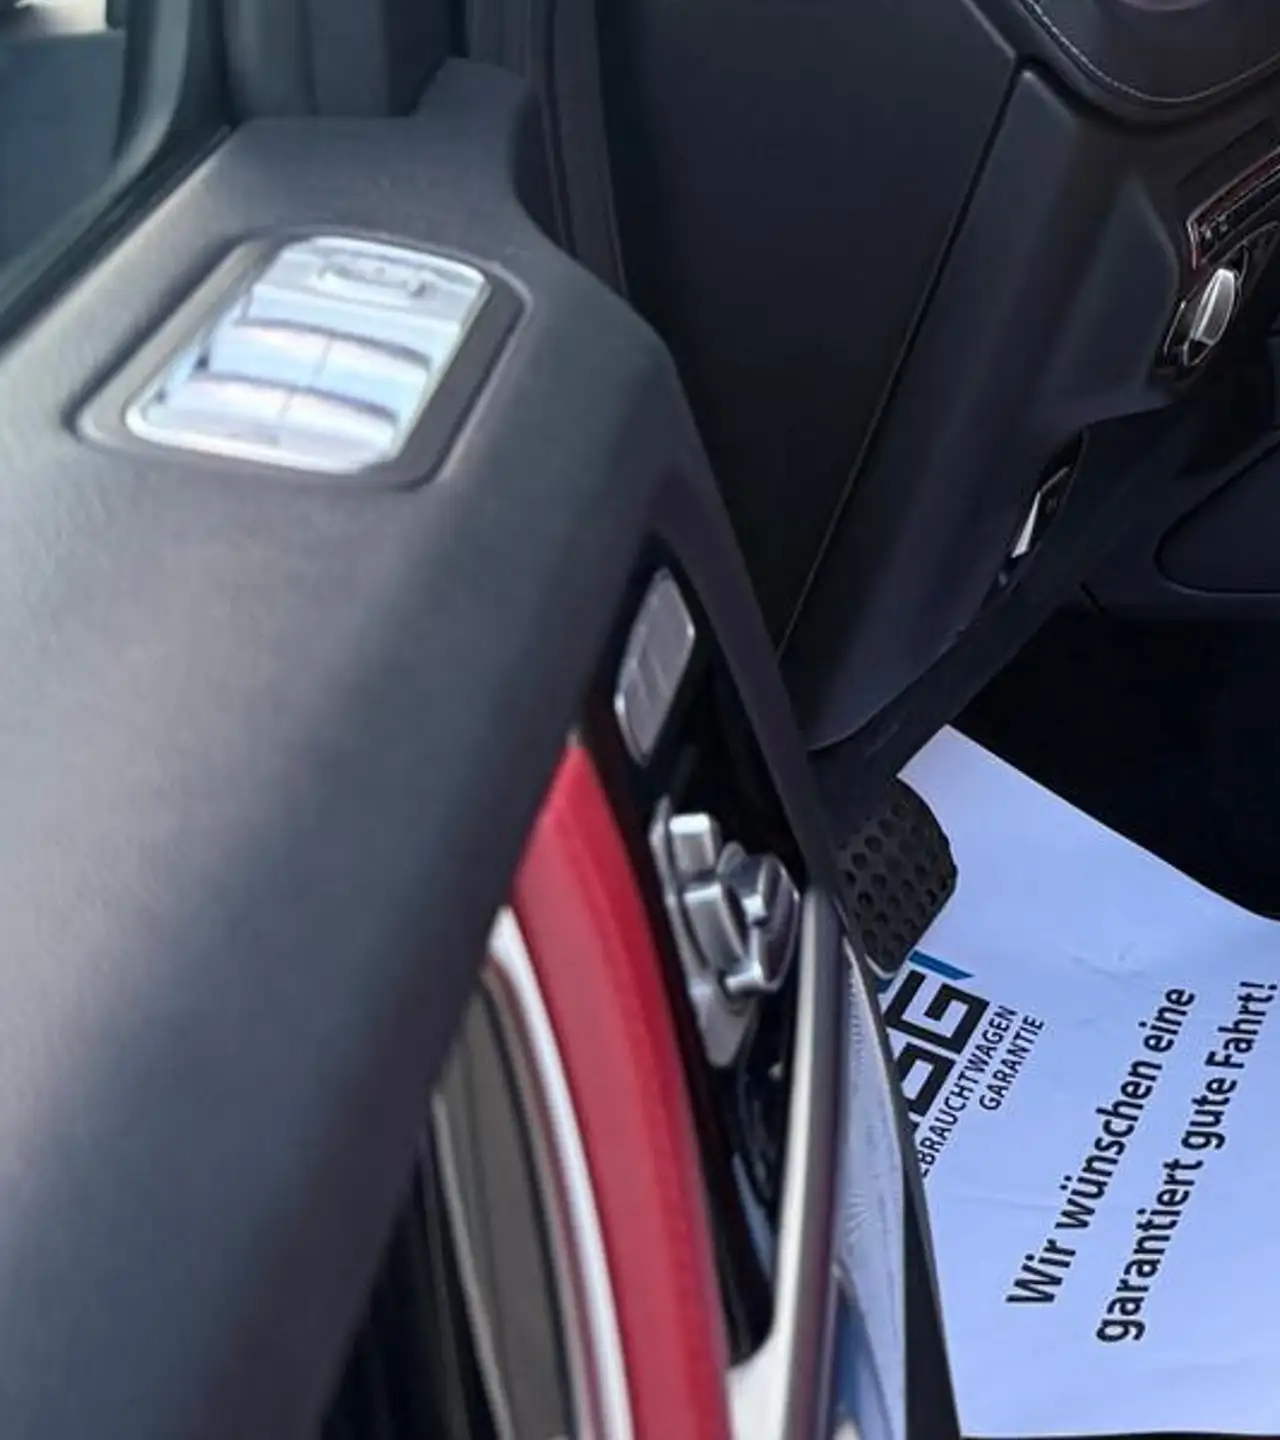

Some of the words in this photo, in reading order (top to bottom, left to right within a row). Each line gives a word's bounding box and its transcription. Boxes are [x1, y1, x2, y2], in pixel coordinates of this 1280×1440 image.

[979, 1014, 1046, 1112] GARANTIE
[1204, 981, 1279, 1069] Fahrt!
[1005, 1237, 1077, 1305] Wir
[1055, 1058, 1164, 1231] wünschen
[1138, 987, 1196, 1053] eine
[1181, 1076, 1238, 1151] gute
[1096, 1158, 1204, 1343] garantiert
